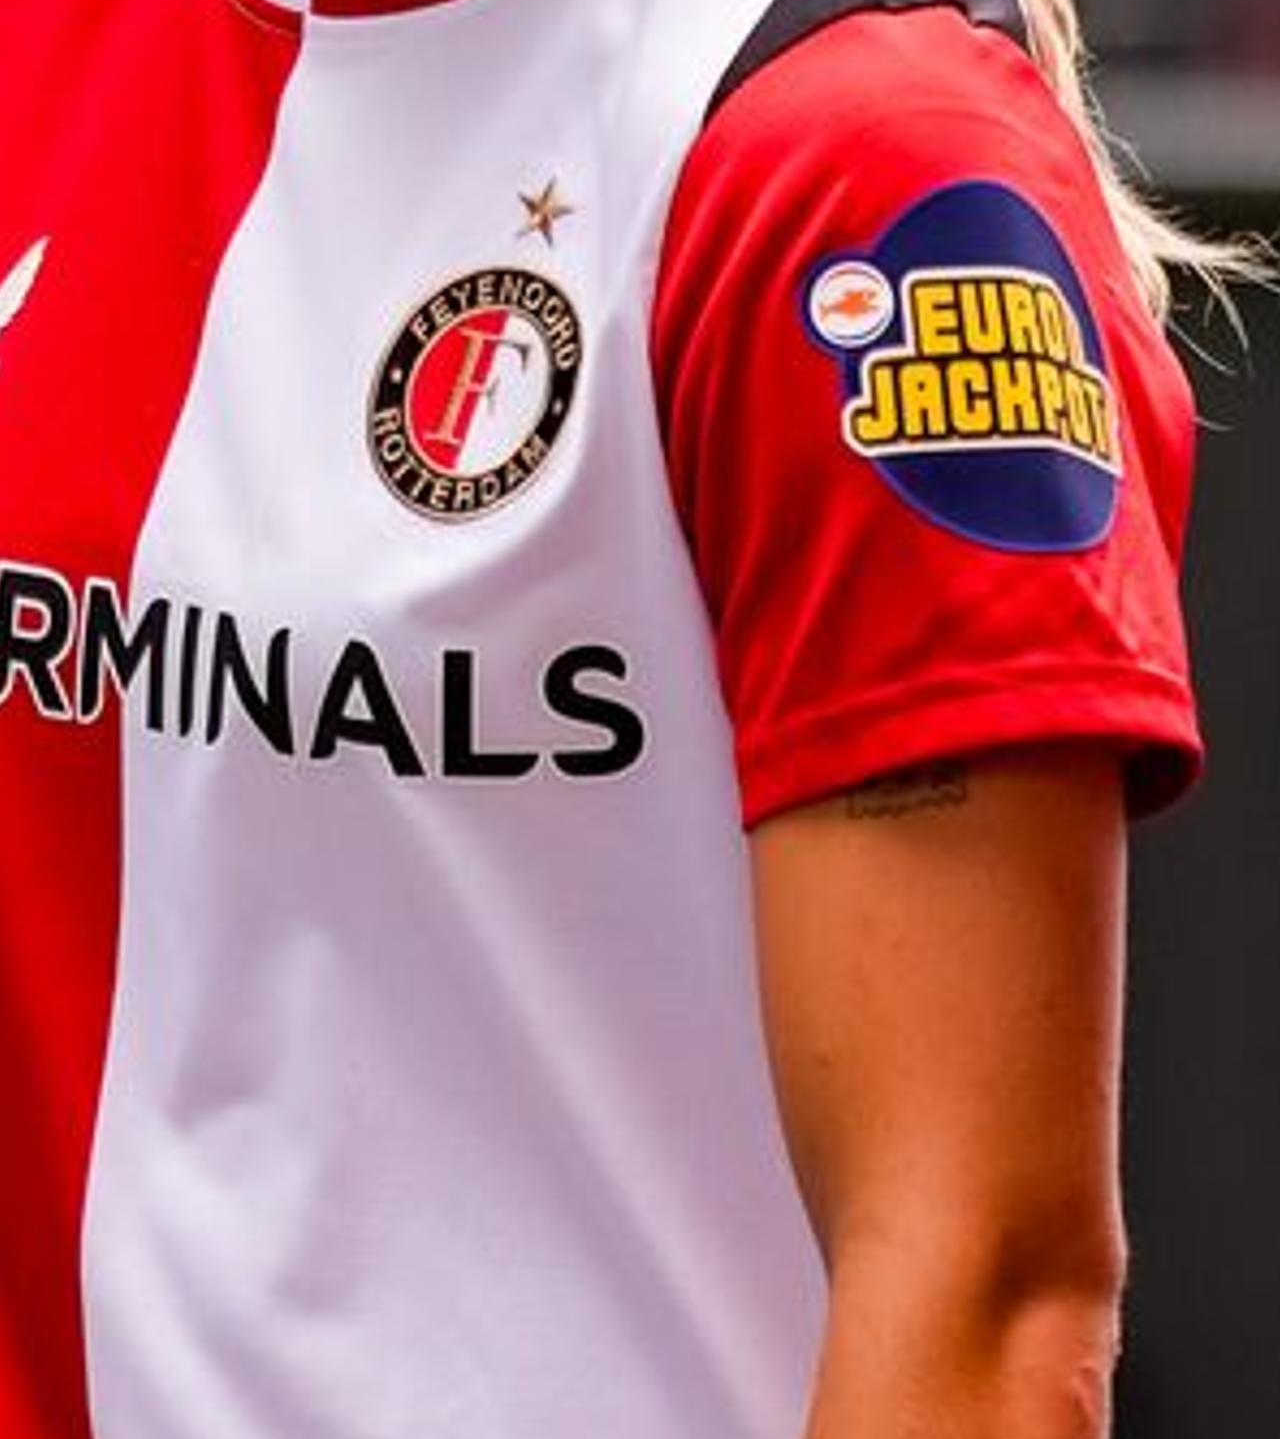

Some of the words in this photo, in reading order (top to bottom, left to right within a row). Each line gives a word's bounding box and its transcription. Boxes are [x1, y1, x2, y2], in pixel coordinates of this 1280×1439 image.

[914, 280, 1069, 365] EURO
[372, 406, 554, 511] ROTTERDAM
[855, 356, 1108, 460] JACKPOT
